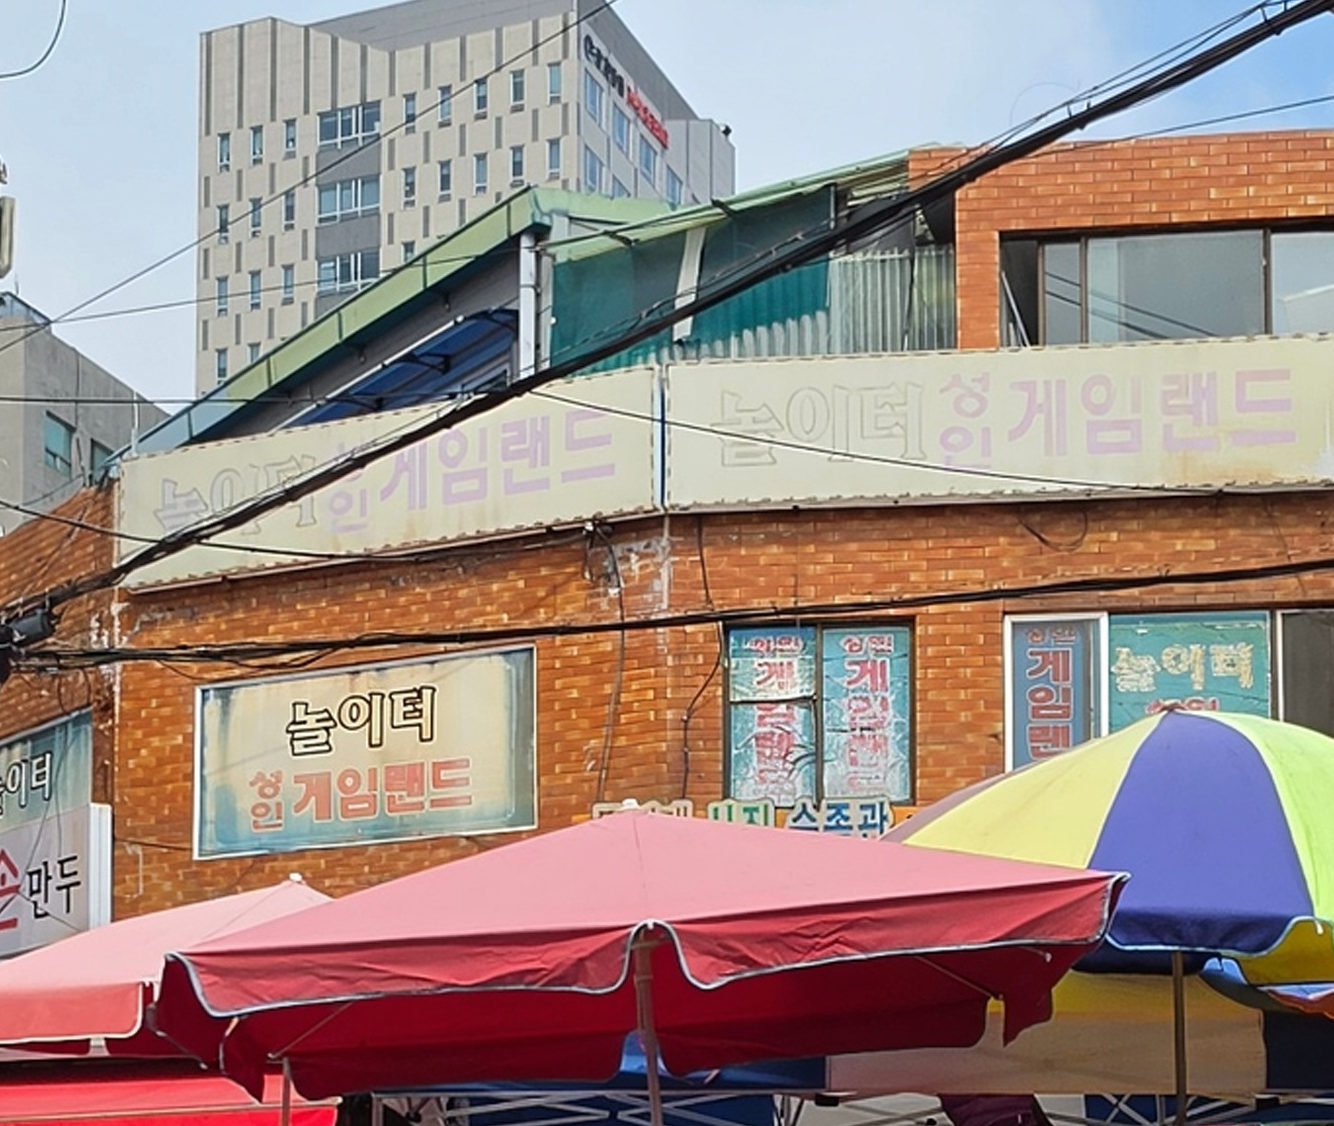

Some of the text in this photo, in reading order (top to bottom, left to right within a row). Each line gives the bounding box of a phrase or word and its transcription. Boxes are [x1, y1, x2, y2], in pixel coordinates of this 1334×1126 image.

[379, 411, 616, 511] 게임랜드
[718, 381, 927, 468] 놀이터
[1008, 368, 1298, 457] 게임랜드
[285, 687, 437, 756] 놀이터
[1026, 648, 1074, 761] 게임랜
[292, 757, 474, 821] 게임랜드
